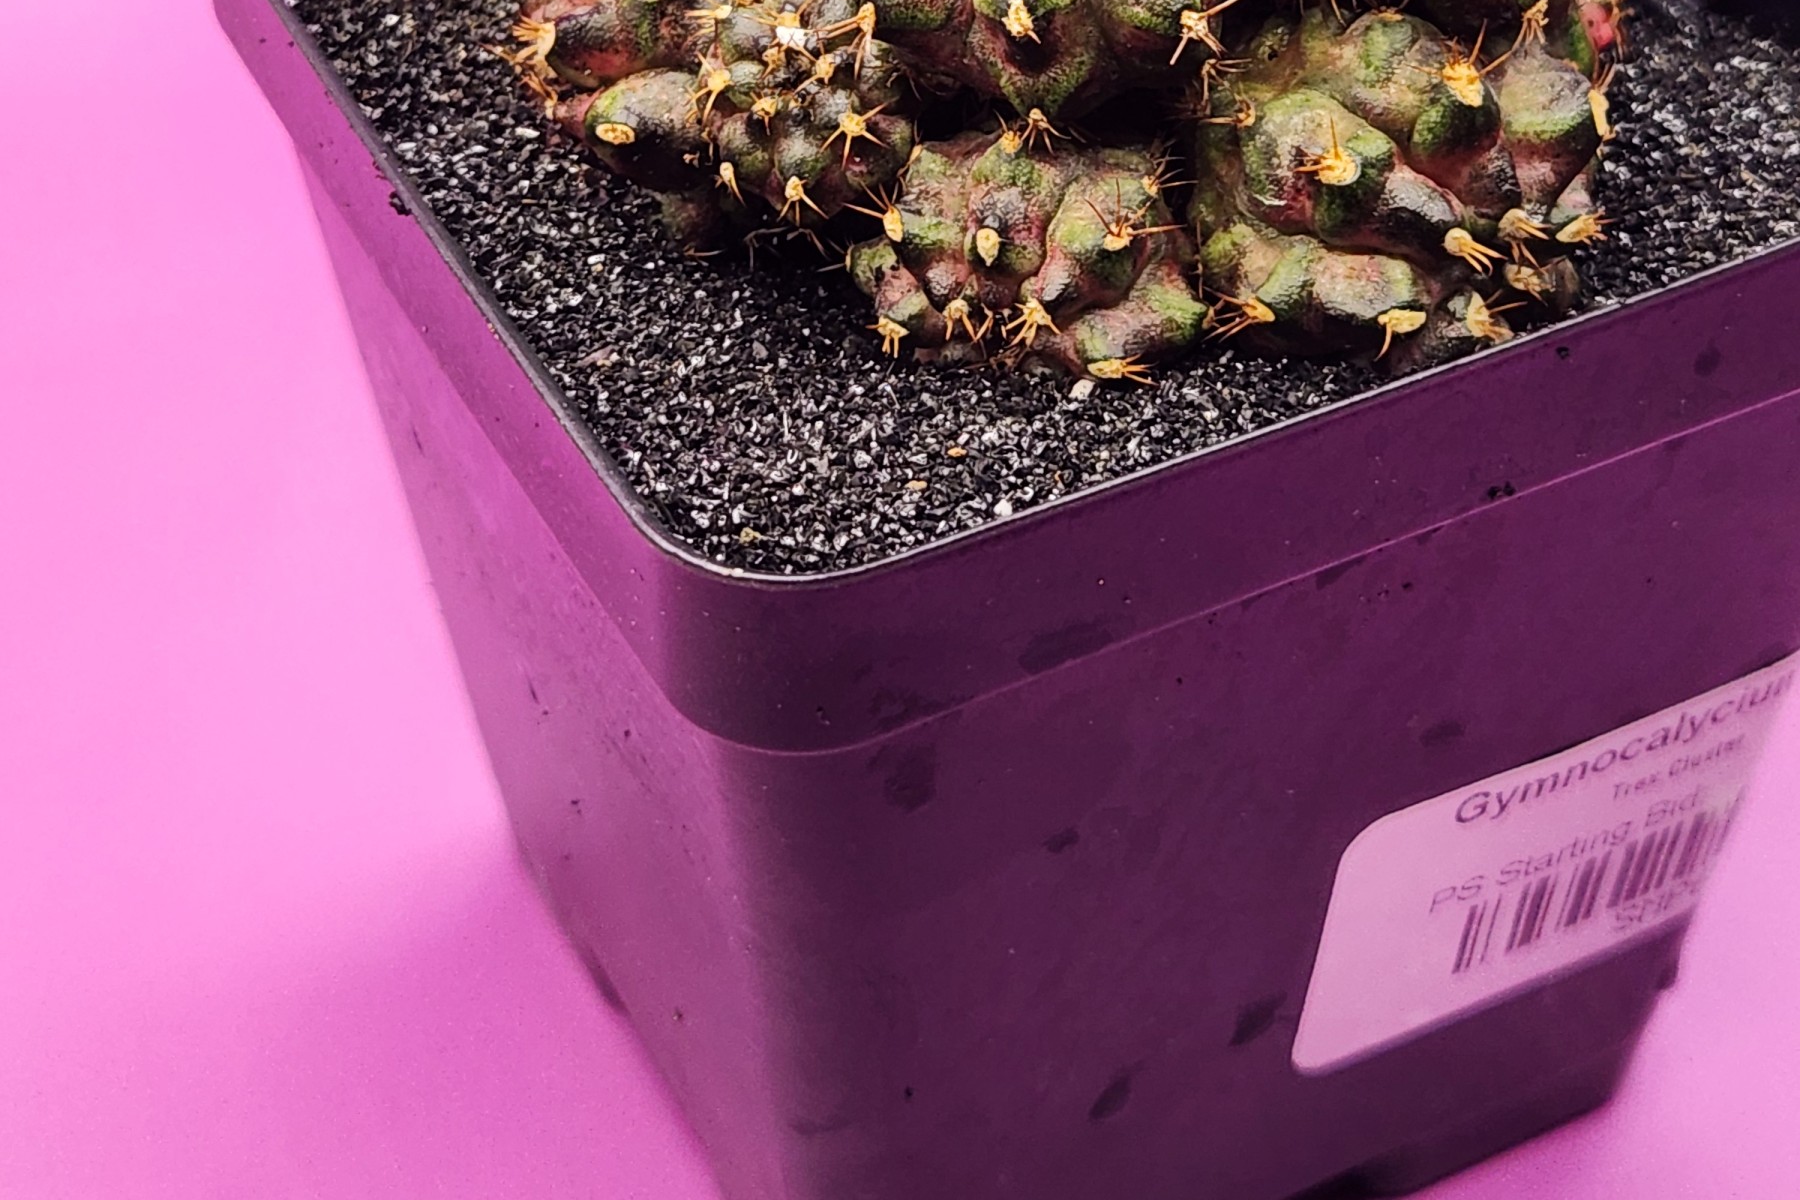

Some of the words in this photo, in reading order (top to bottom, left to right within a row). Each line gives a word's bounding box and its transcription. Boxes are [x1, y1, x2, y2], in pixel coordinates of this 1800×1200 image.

[1429, 874, 1485, 914] PS
[1496, 820, 1634, 886] Starting
[1645, 784, 1701, 827] Bid
